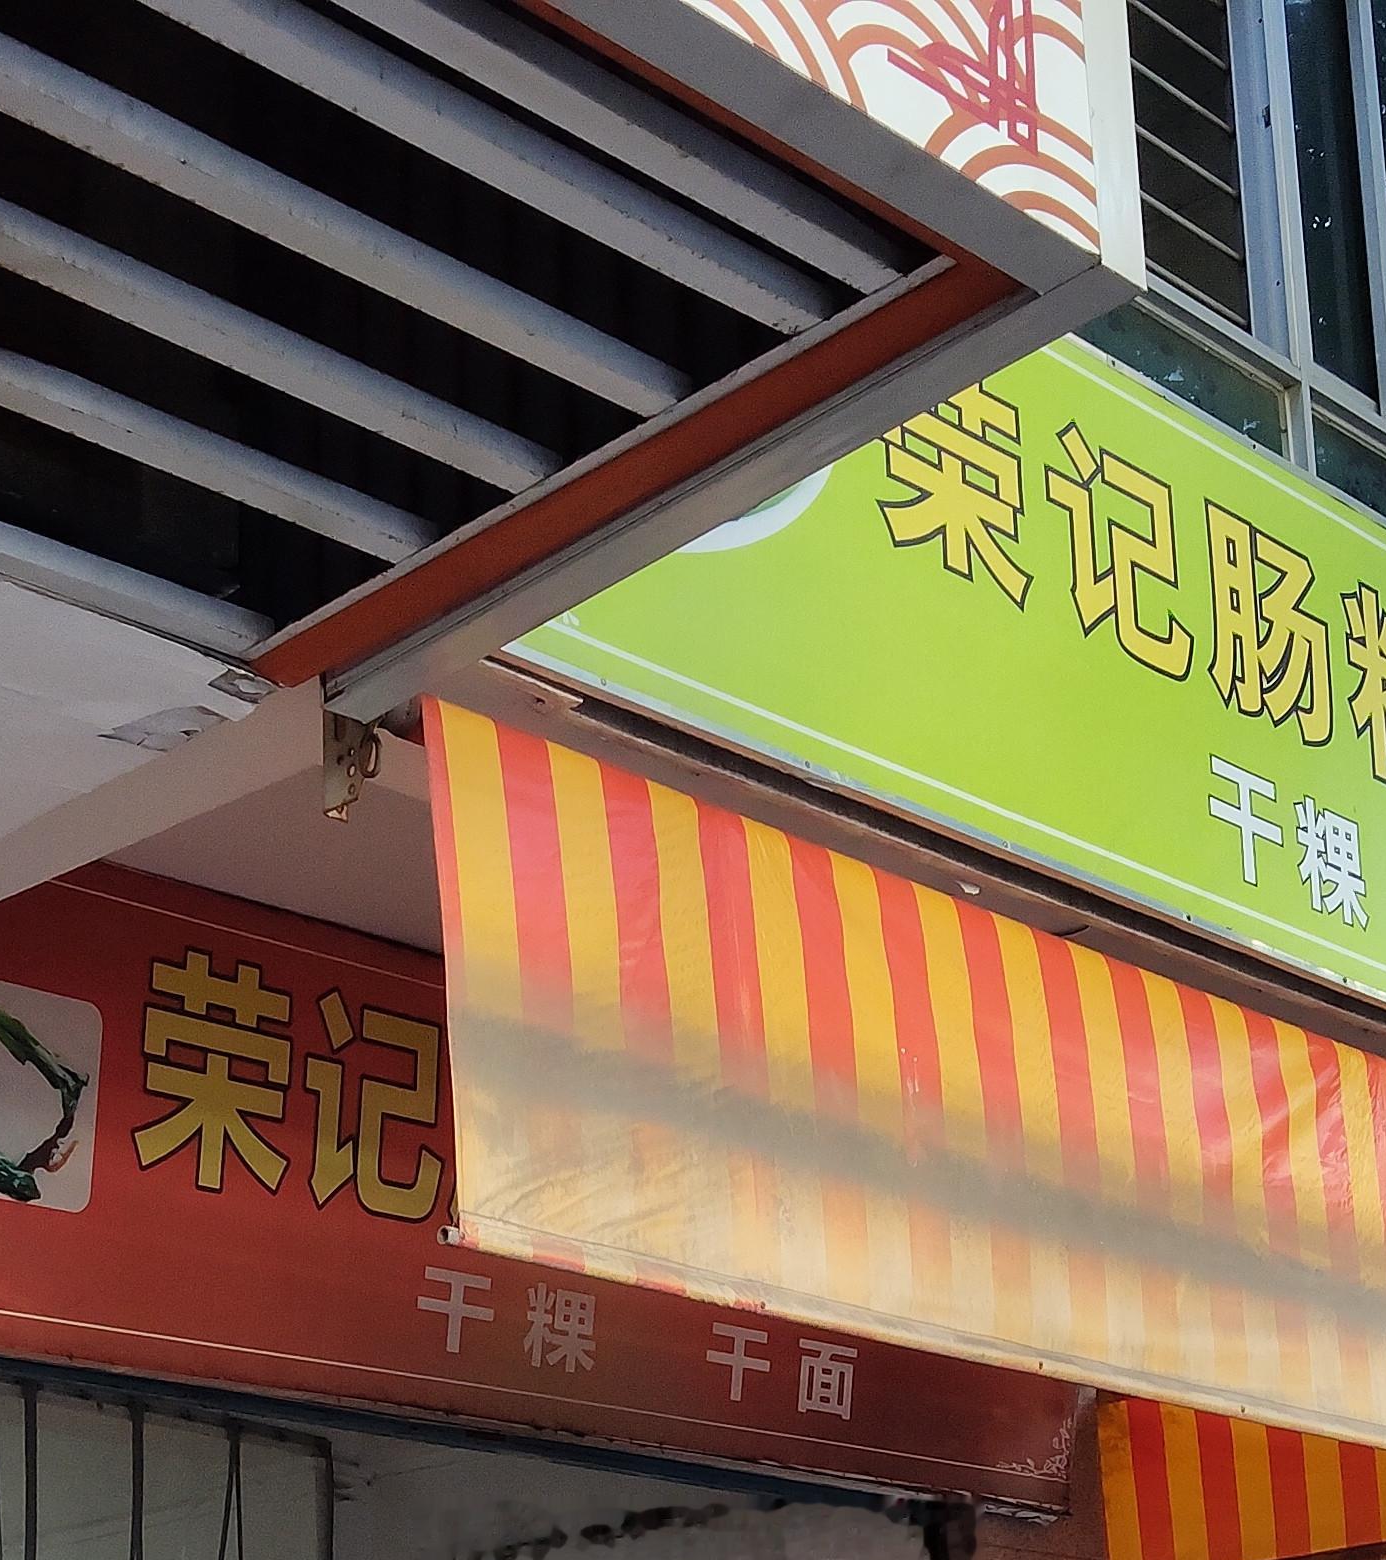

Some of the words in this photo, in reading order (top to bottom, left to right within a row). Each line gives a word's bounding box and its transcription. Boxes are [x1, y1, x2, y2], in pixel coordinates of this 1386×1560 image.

[1207, 753, 1371, 931] 干粿
[131, 946, 459, 1224] 荣记
[416, 1263, 599, 1375] 干粿
[706, 1321, 858, 1421] 干面
